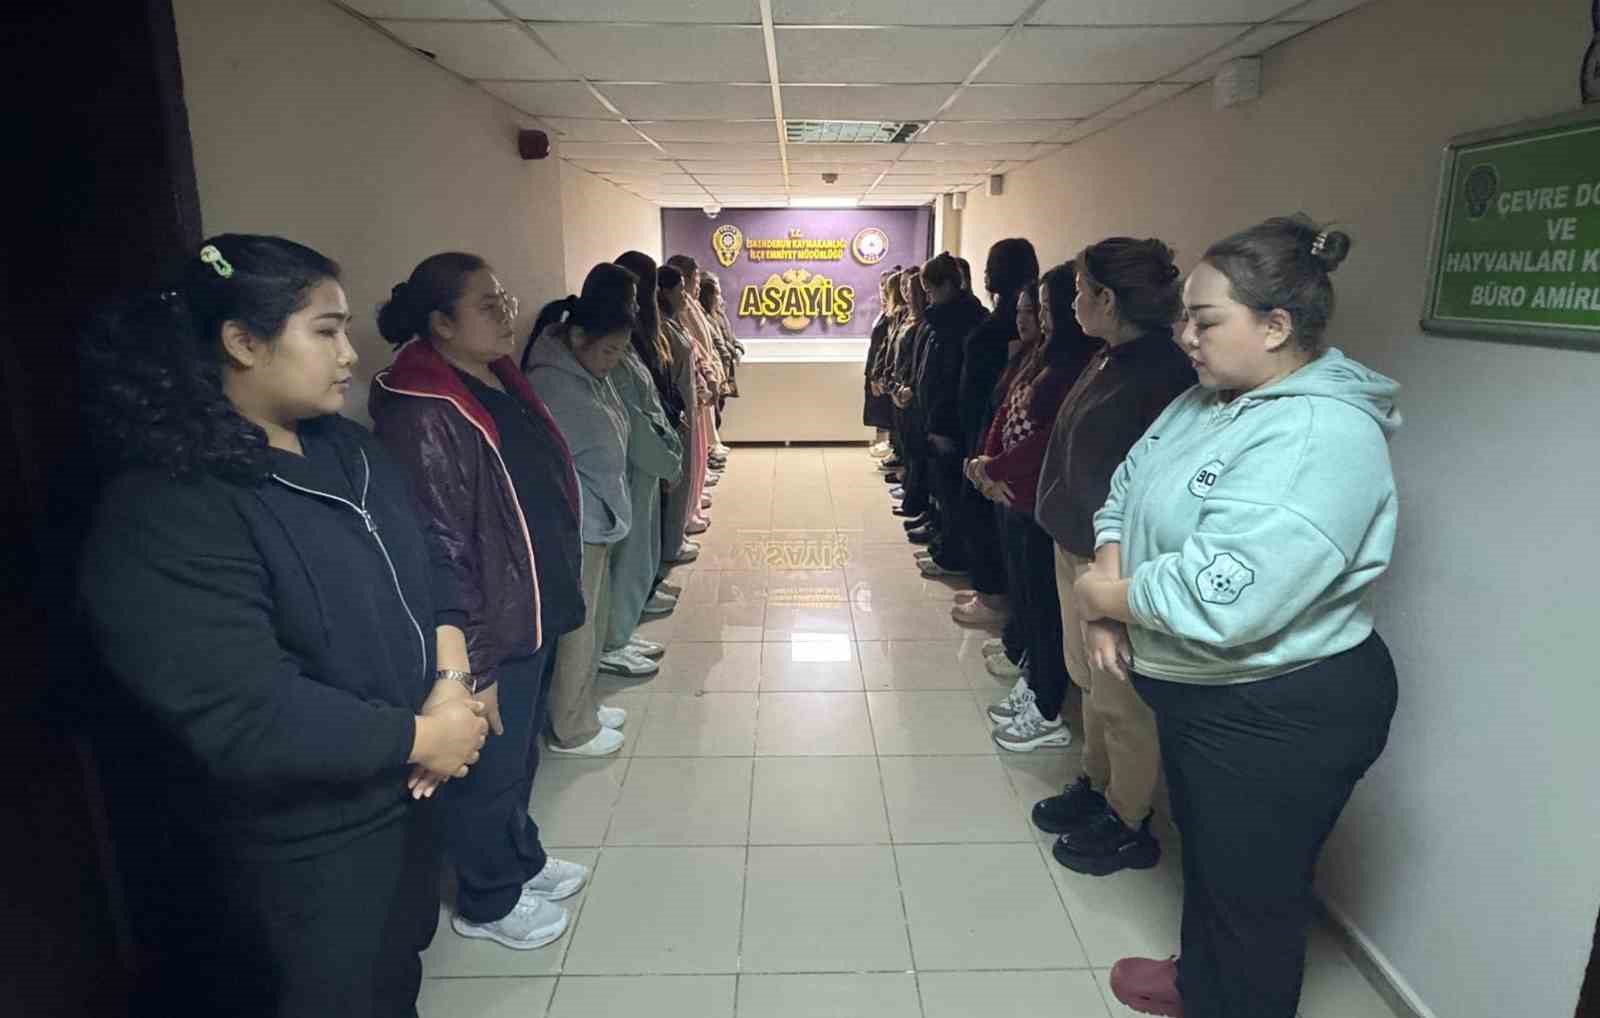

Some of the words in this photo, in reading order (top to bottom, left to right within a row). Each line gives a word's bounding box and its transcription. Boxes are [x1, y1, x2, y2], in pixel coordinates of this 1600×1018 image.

[1498, 186, 1569, 218] ÇEVRE
[1547, 217, 1577, 240] VE
[1446, 249, 1576, 272] HAYVANLARI
[739, 278, 855, 324] ASAYİŞ
[1470, 282, 1526, 306] BÜRO
